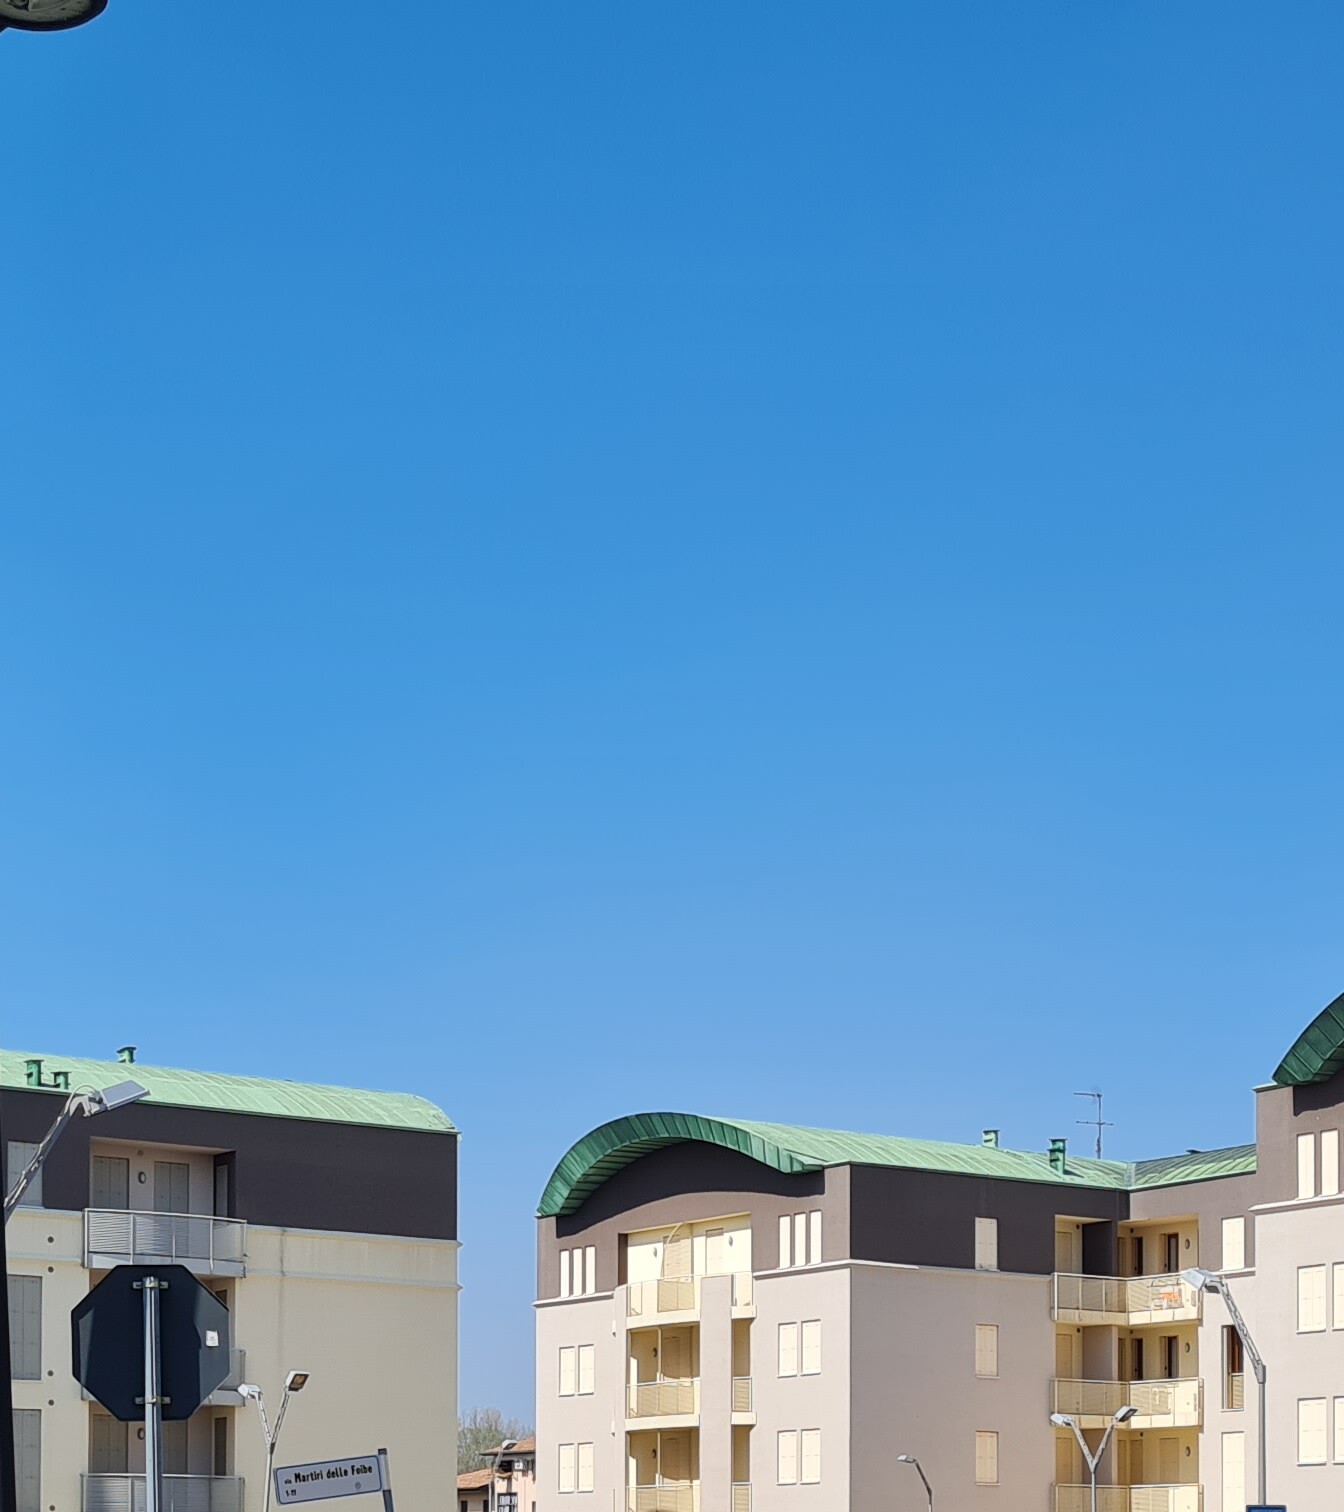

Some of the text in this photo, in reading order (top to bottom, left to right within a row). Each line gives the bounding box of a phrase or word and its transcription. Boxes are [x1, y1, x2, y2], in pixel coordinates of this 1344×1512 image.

[294, 1470, 323, 1484] Martiri
[326, 1467, 348, 1479] delle
[351, 1465, 373, 1476] Foibe
